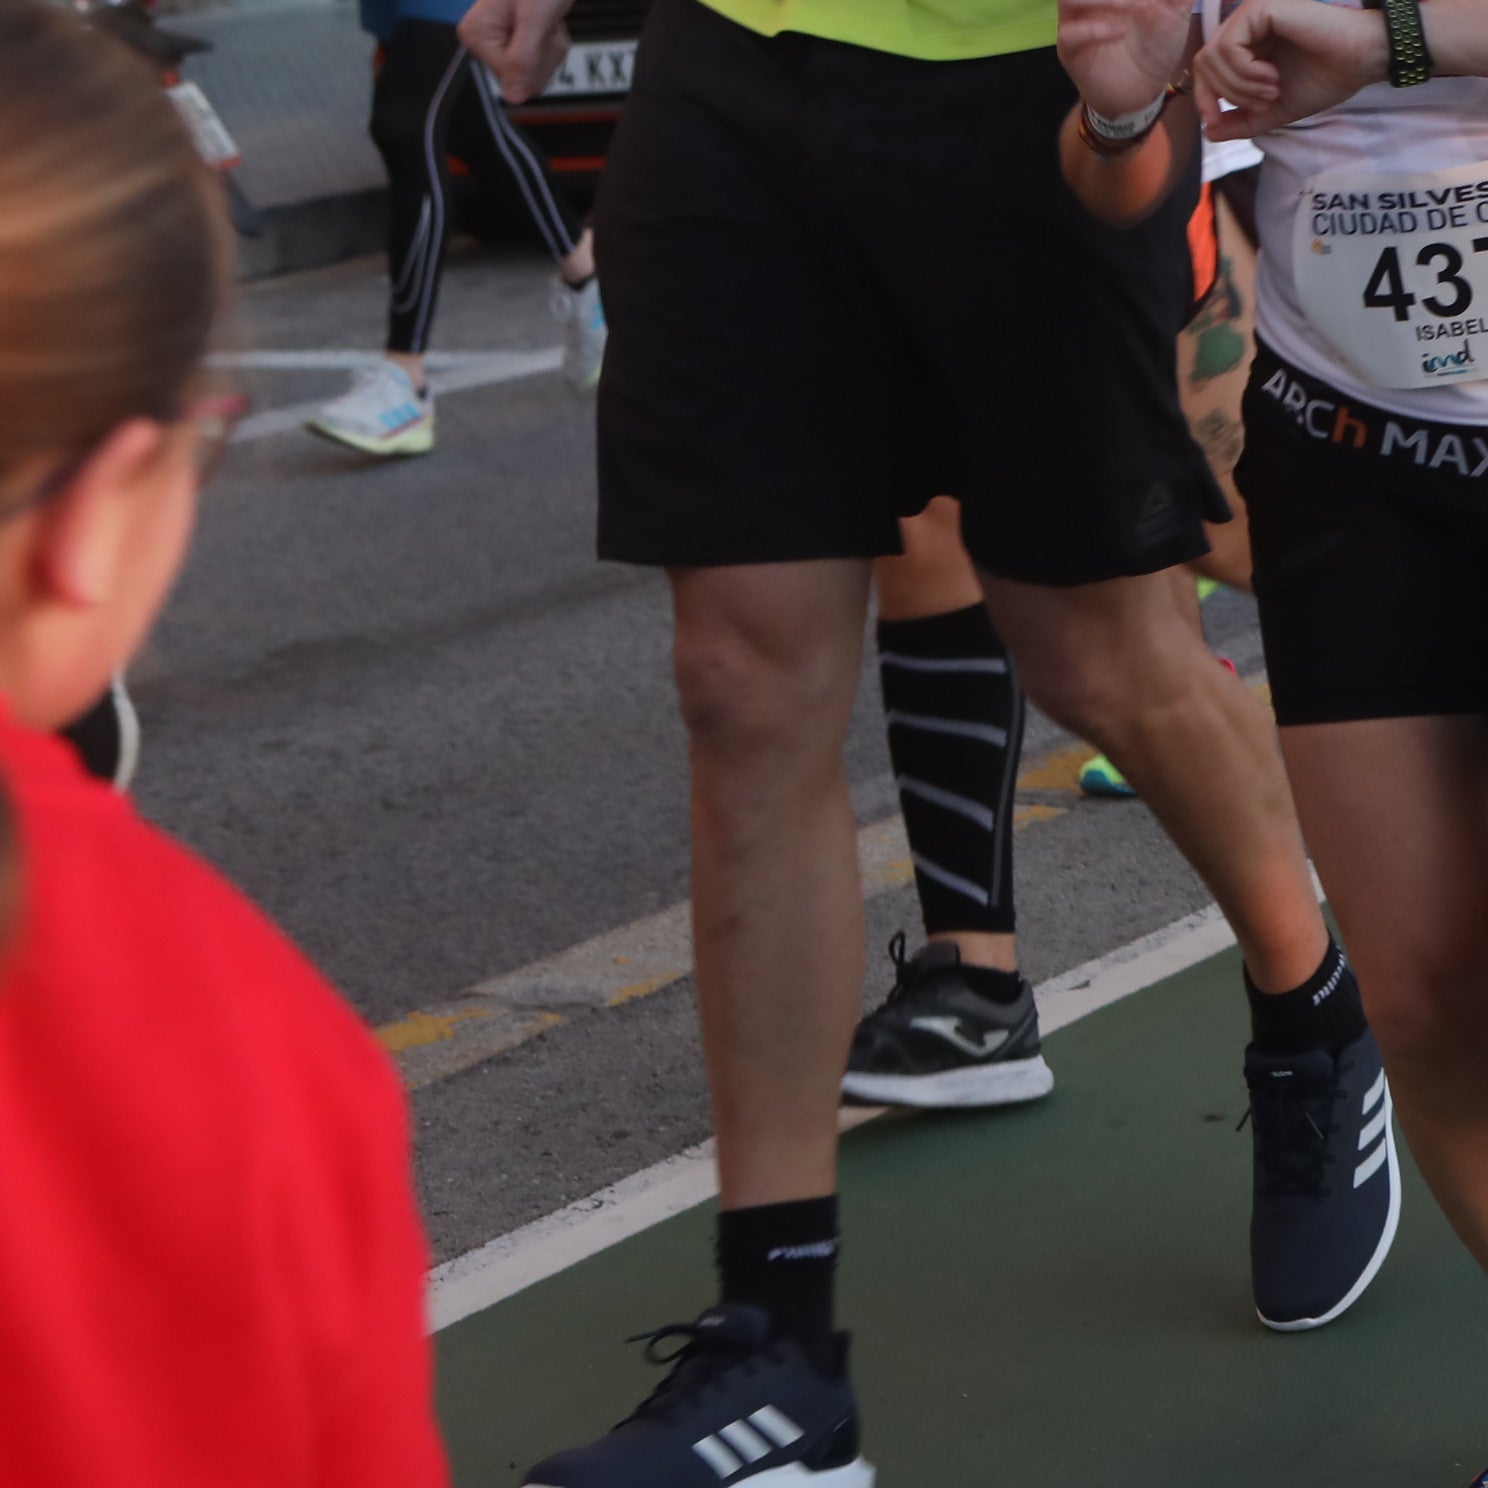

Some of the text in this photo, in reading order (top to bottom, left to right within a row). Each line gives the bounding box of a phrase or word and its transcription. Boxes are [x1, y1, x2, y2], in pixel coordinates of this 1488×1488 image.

[1312, 191, 1372, 212] SAN
[1311, 210, 1418, 237] CIUDAD
[1421, 204, 1469, 232] DE
[1421, 339, 1476, 374] imd
